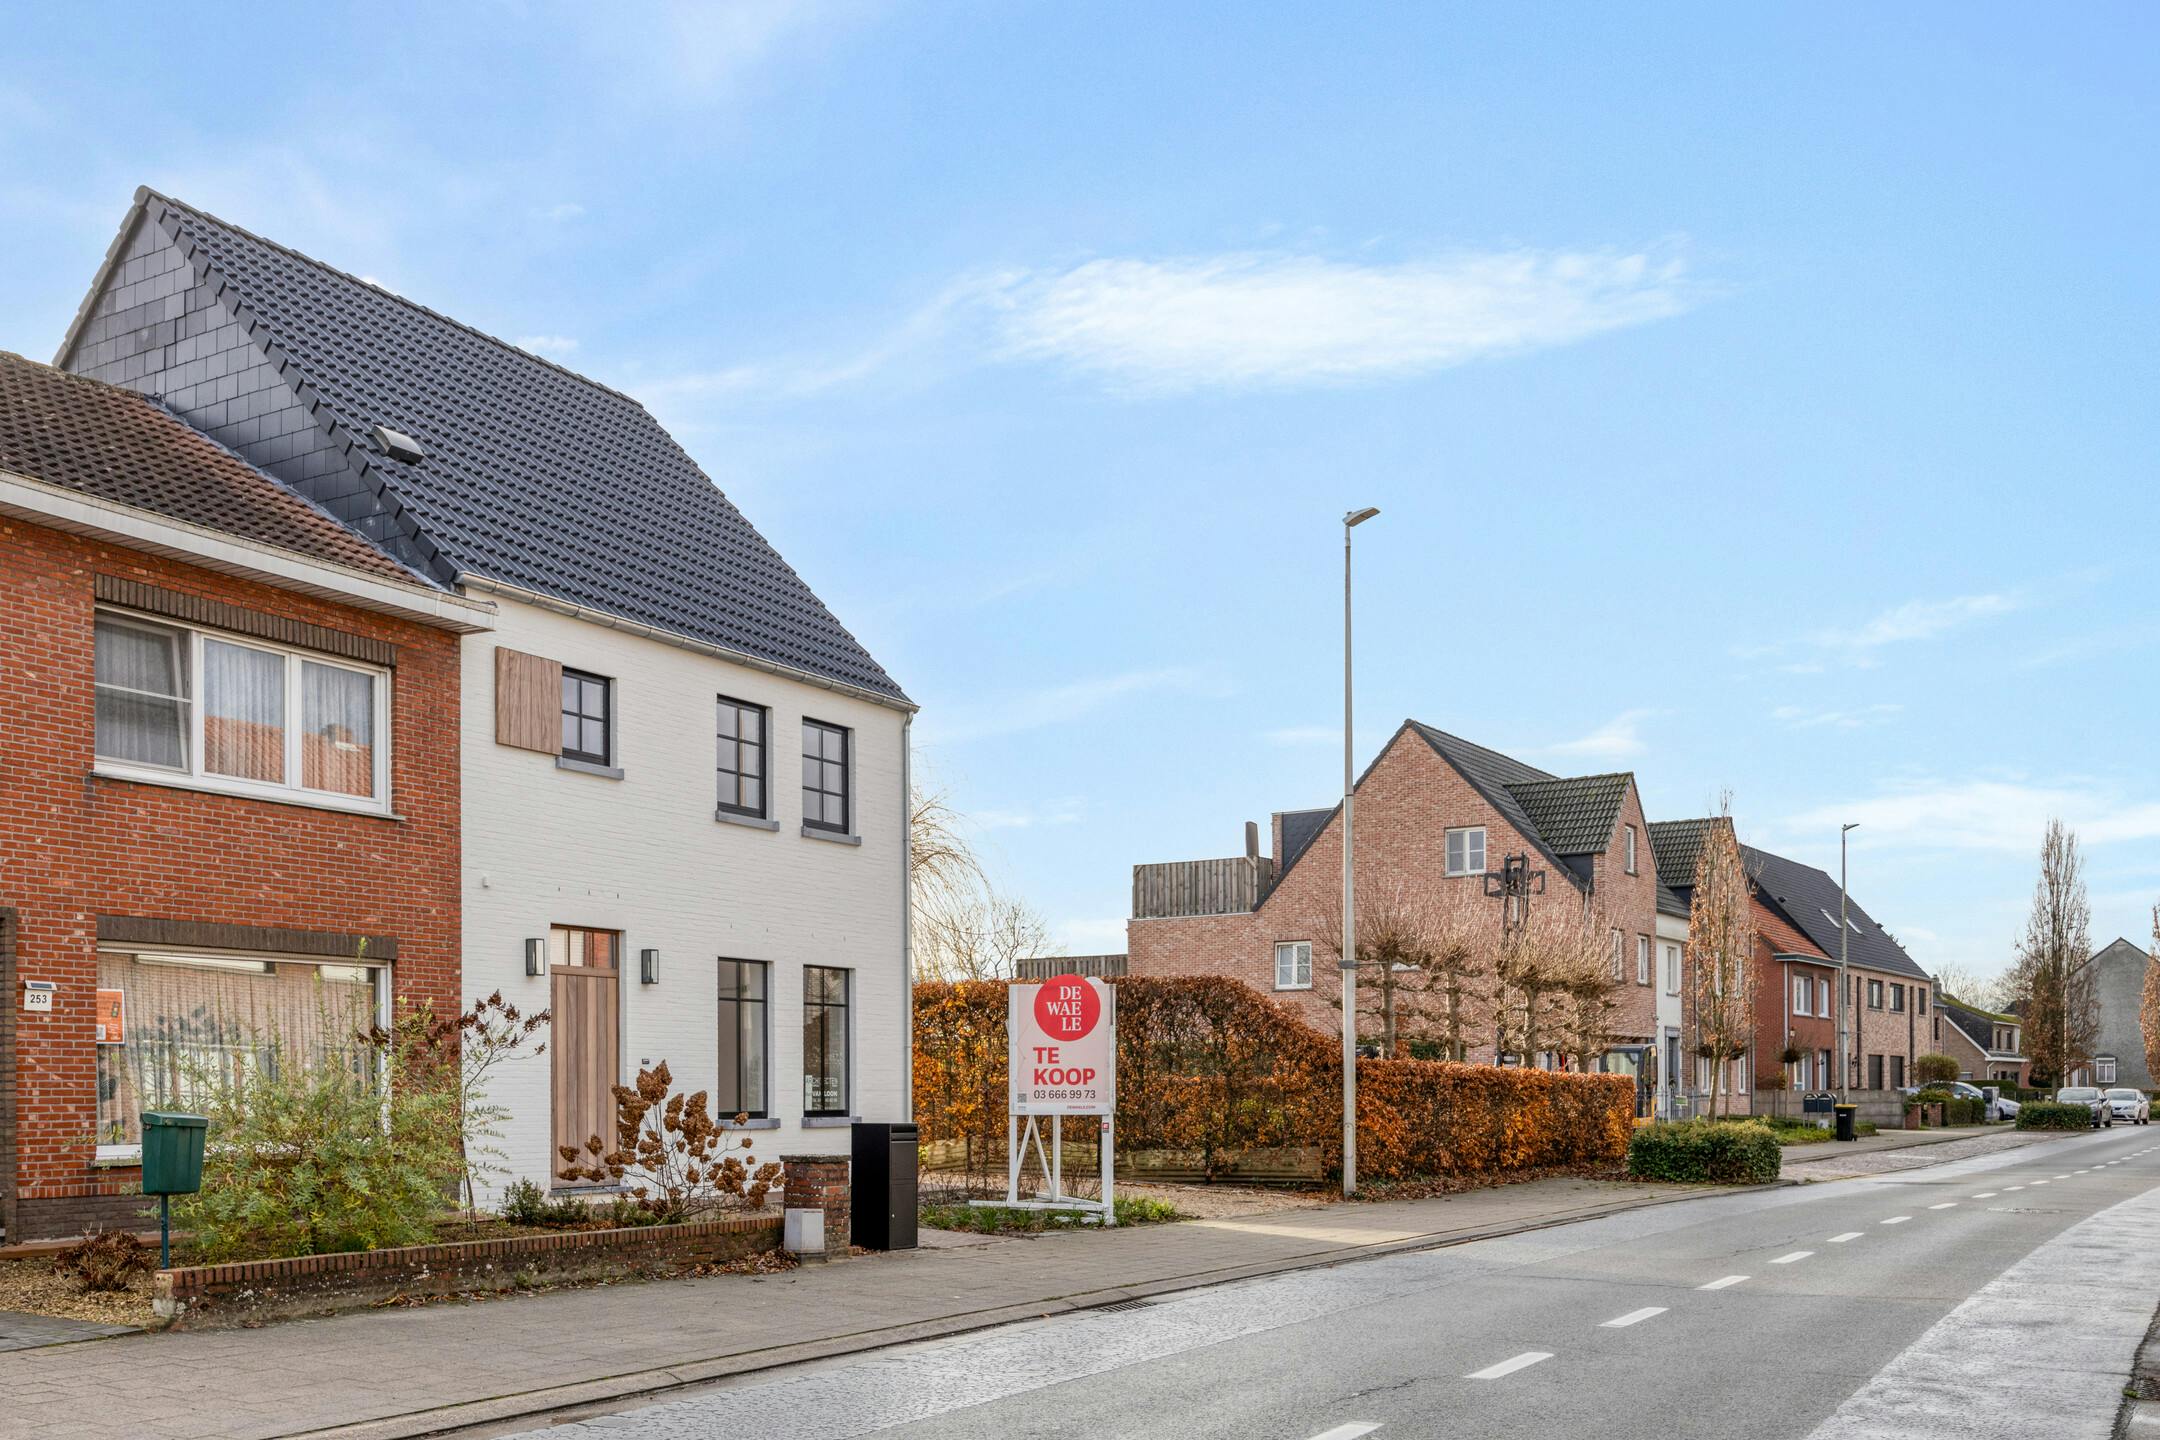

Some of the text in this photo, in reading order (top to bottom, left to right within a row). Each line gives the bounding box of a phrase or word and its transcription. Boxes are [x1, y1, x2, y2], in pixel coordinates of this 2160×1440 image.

[30, 994, 47, 1004] 253
[1060, 986, 1082, 1000] DE
[1047, 1002, 1082, 1016] WAE
[1062, 1017, 1082, 1031] LE
[1033, 1047, 1060, 1064] TE
[1034, 1068, 1096, 1086] KOOP
[1034, 1090, 1096, 1099] 03 666 99 73
